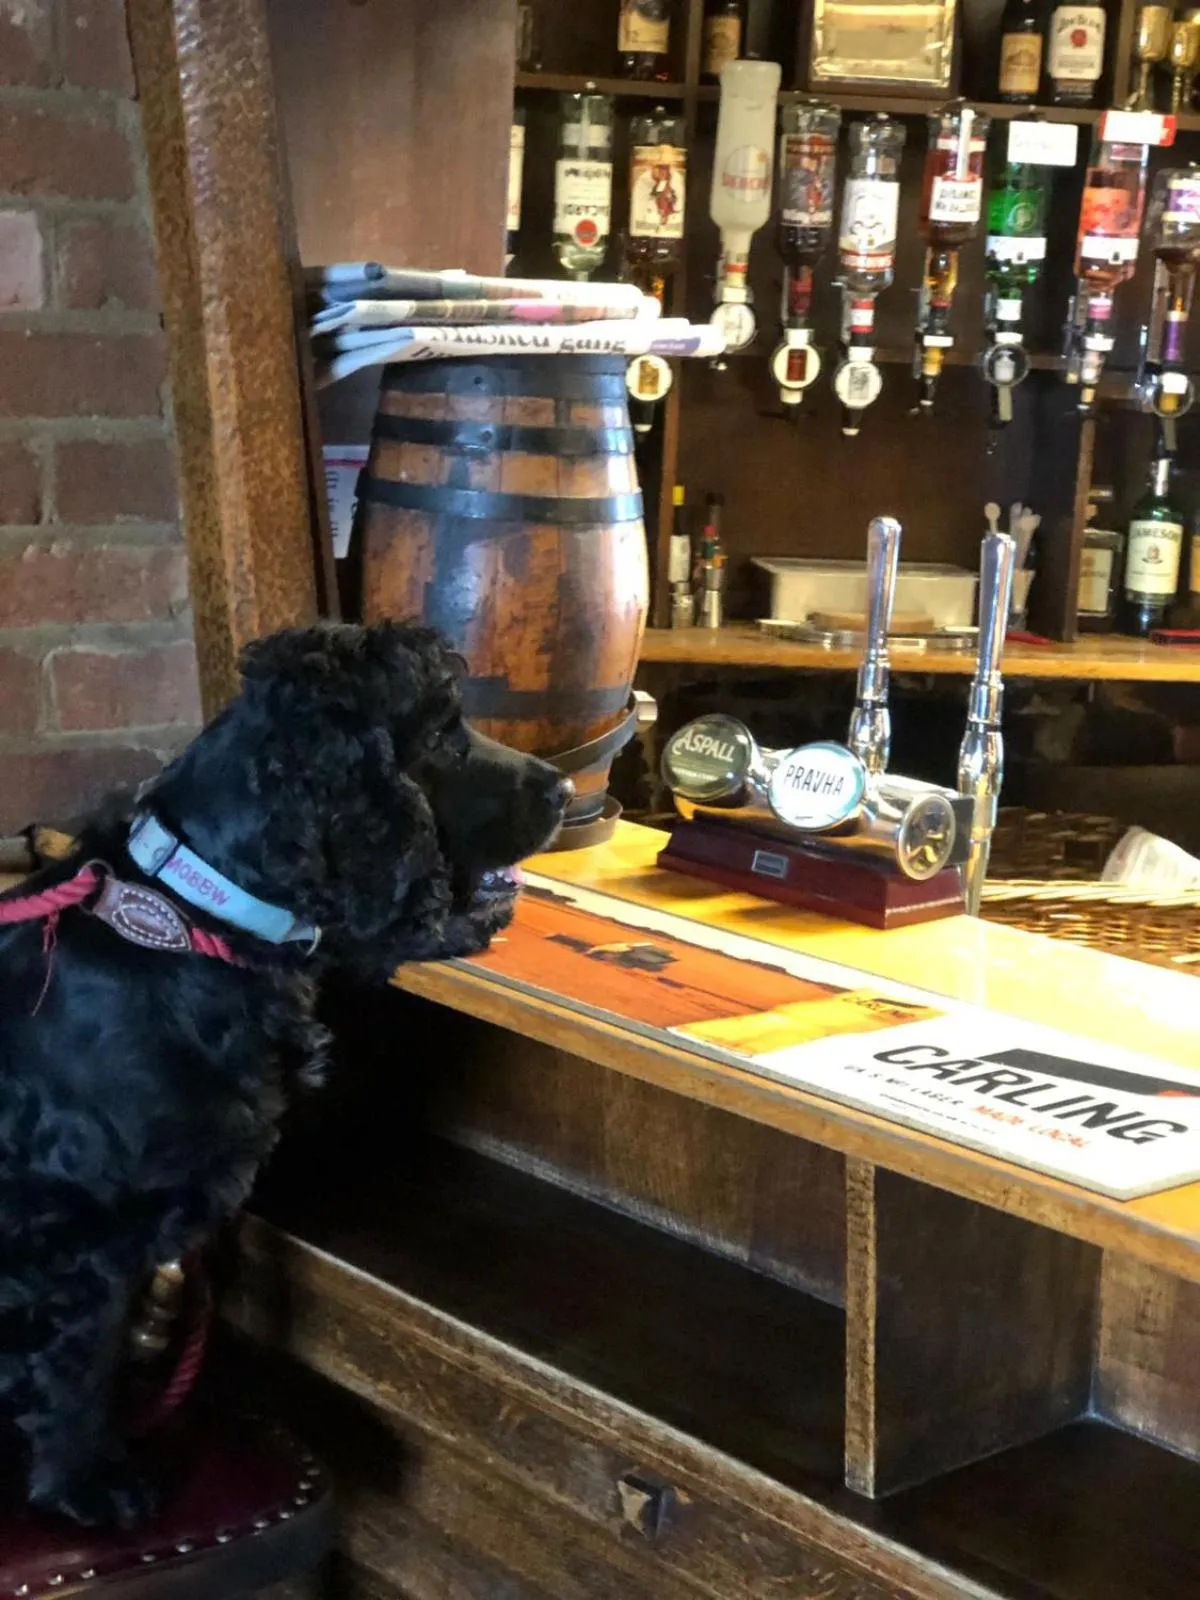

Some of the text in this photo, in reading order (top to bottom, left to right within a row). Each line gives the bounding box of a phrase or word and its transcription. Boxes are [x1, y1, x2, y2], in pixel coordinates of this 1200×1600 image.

[671, 728, 736, 763] ASPALL
[783, 764, 844, 796] PRAVHA
[872, 1044, 1189, 1146] CARLING
